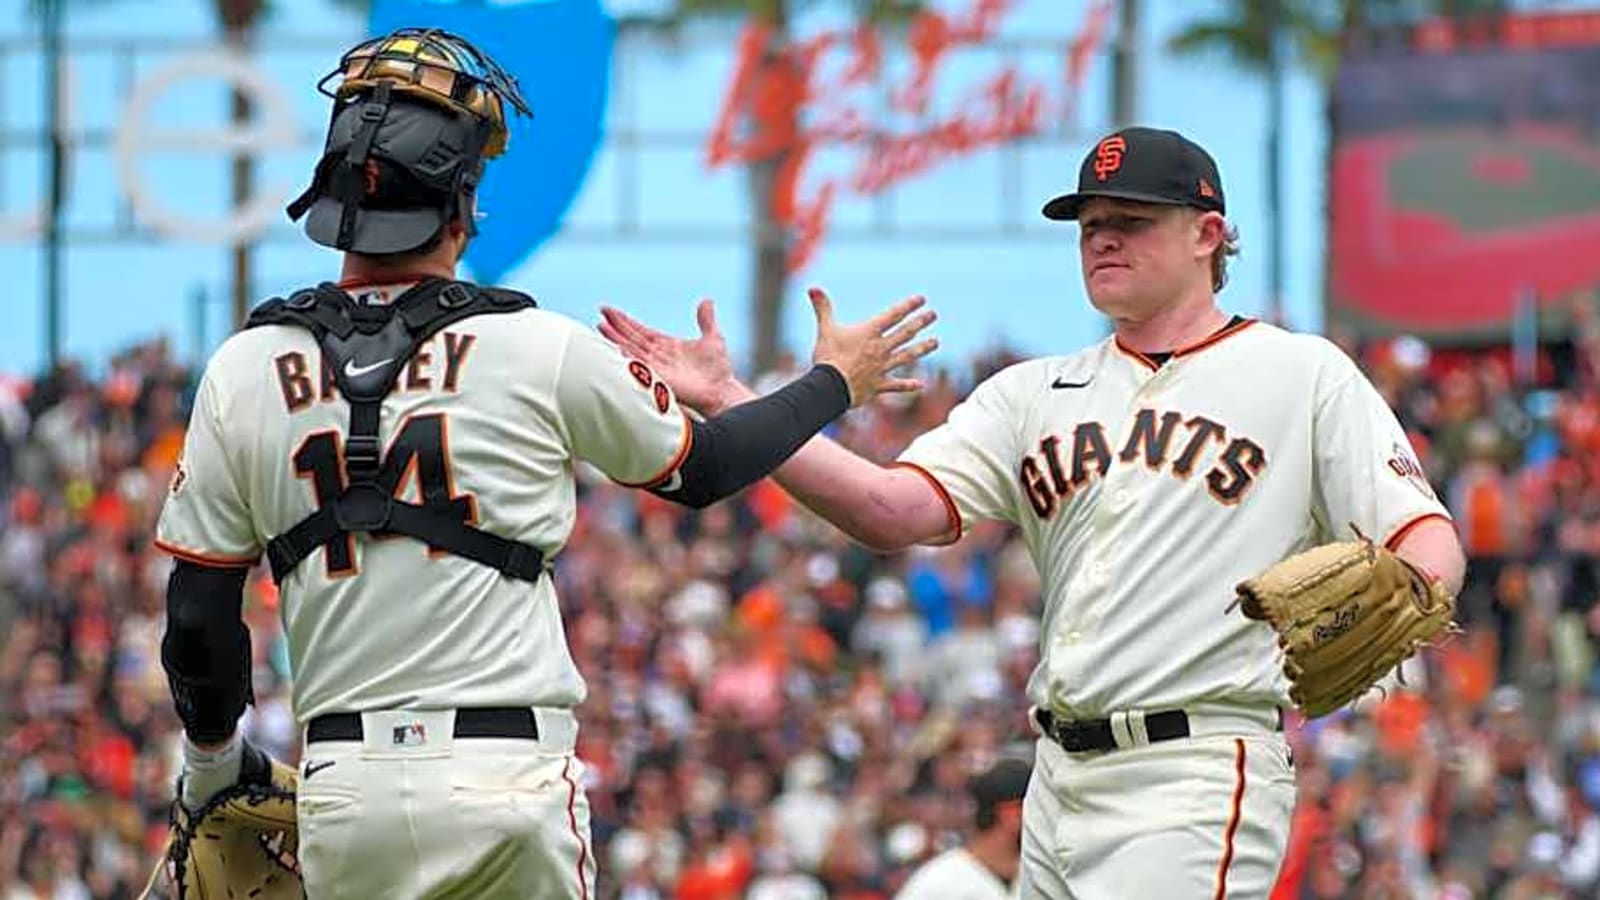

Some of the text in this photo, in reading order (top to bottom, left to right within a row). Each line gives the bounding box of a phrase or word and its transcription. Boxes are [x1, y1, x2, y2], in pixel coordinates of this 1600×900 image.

[1093, 134, 1127, 182] SF
[290, 412, 479, 580] 14
[1019, 407, 1267, 520] GIANTS
